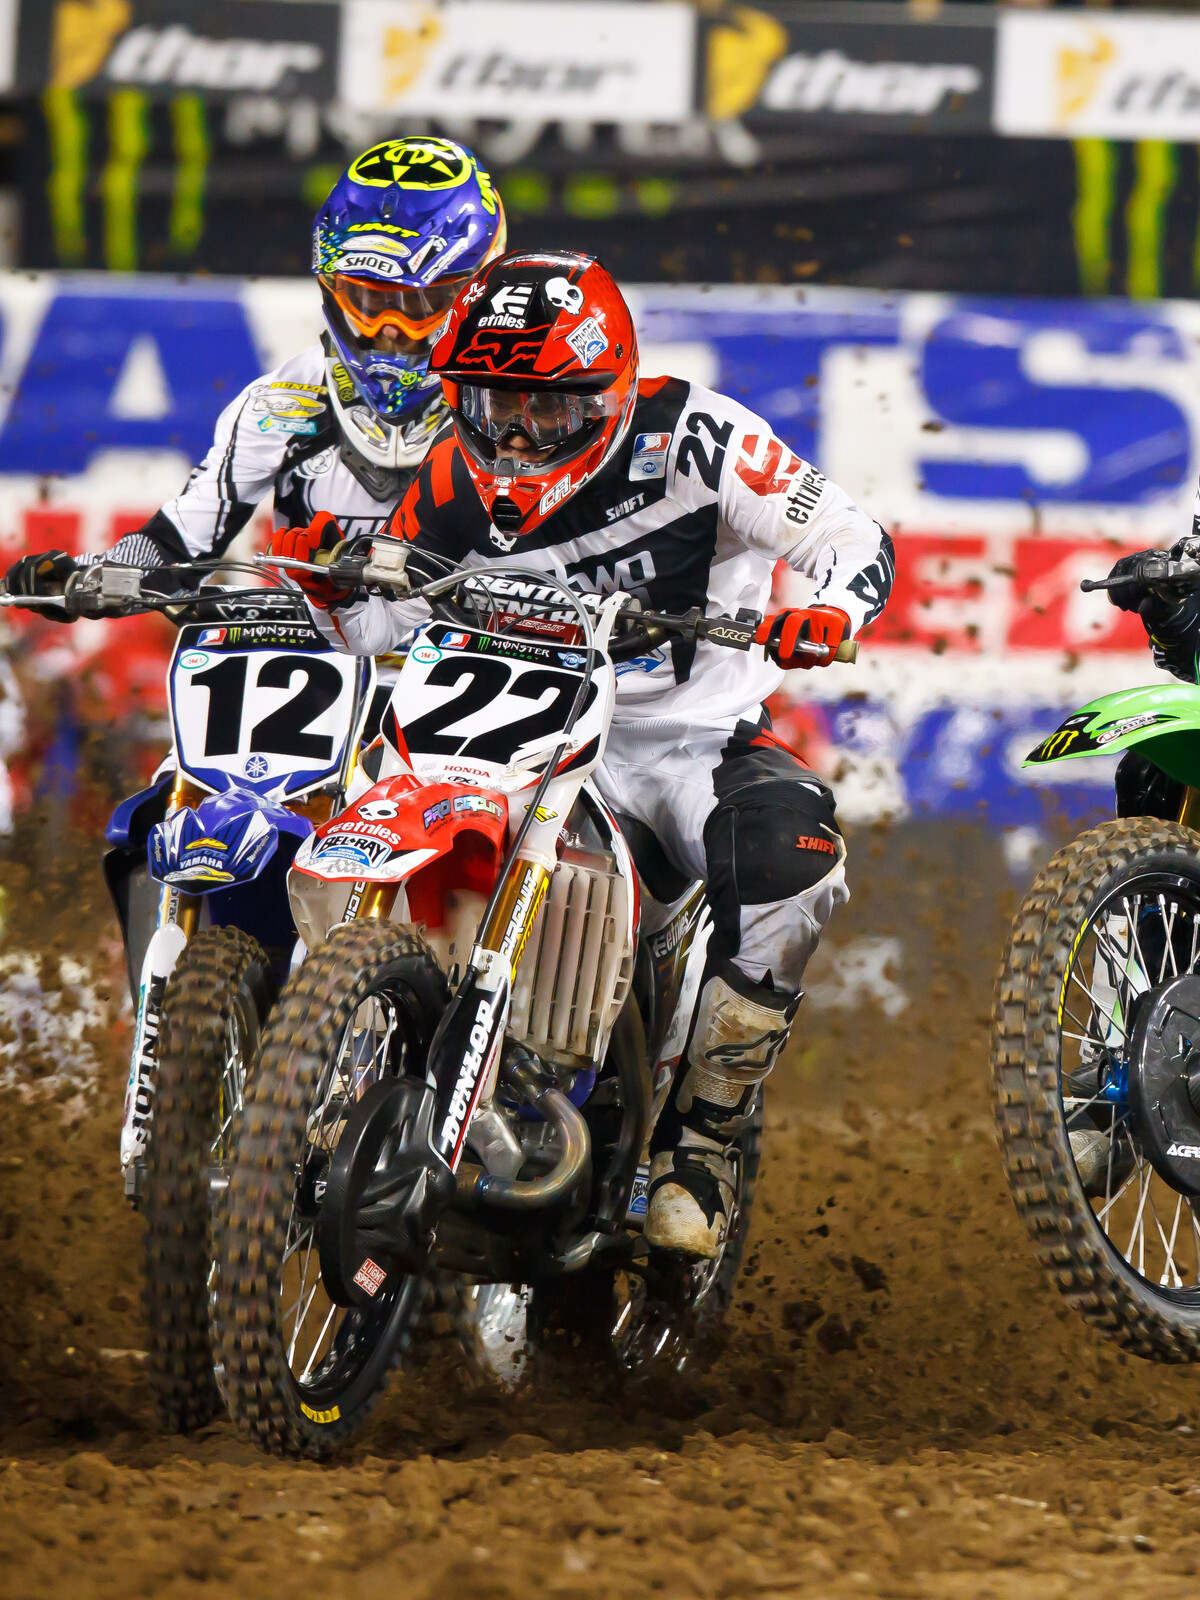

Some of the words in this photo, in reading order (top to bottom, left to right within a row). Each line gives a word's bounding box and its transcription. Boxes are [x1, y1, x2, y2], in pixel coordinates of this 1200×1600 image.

[347, 222, 420, 238] UNIT
[344, 256, 394, 273] SHOEI
[478, 315, 526, 329] etnies
[674, 411, 735, 492] 22
[606, 492, 645, 522] SHIFT
[785, 467, 827, 525] etnies
[463, 575, 602, 609] RENTHA
[243, 626, 317, 639] MONSTER
[707, 627, 752, 643] ARC
[491, 639, 550, 658] MONSTER
[190, 655, 343, 761] 12
[400, 656, 599, 765] 22
[444, 765, 490, 778] HONDA
[423, 799, 451, 831] PRO
[342, 821, 401, 845] etnies
[796, 835, 836, 856] SHIFT
[180, 856, 223, 869] YAMAHA
[442, 1000, 493, 1148] DUNLOP
[363, 1258, 387, 1281] LIGHT
[354, 1271, 379, 1295] SPEED
